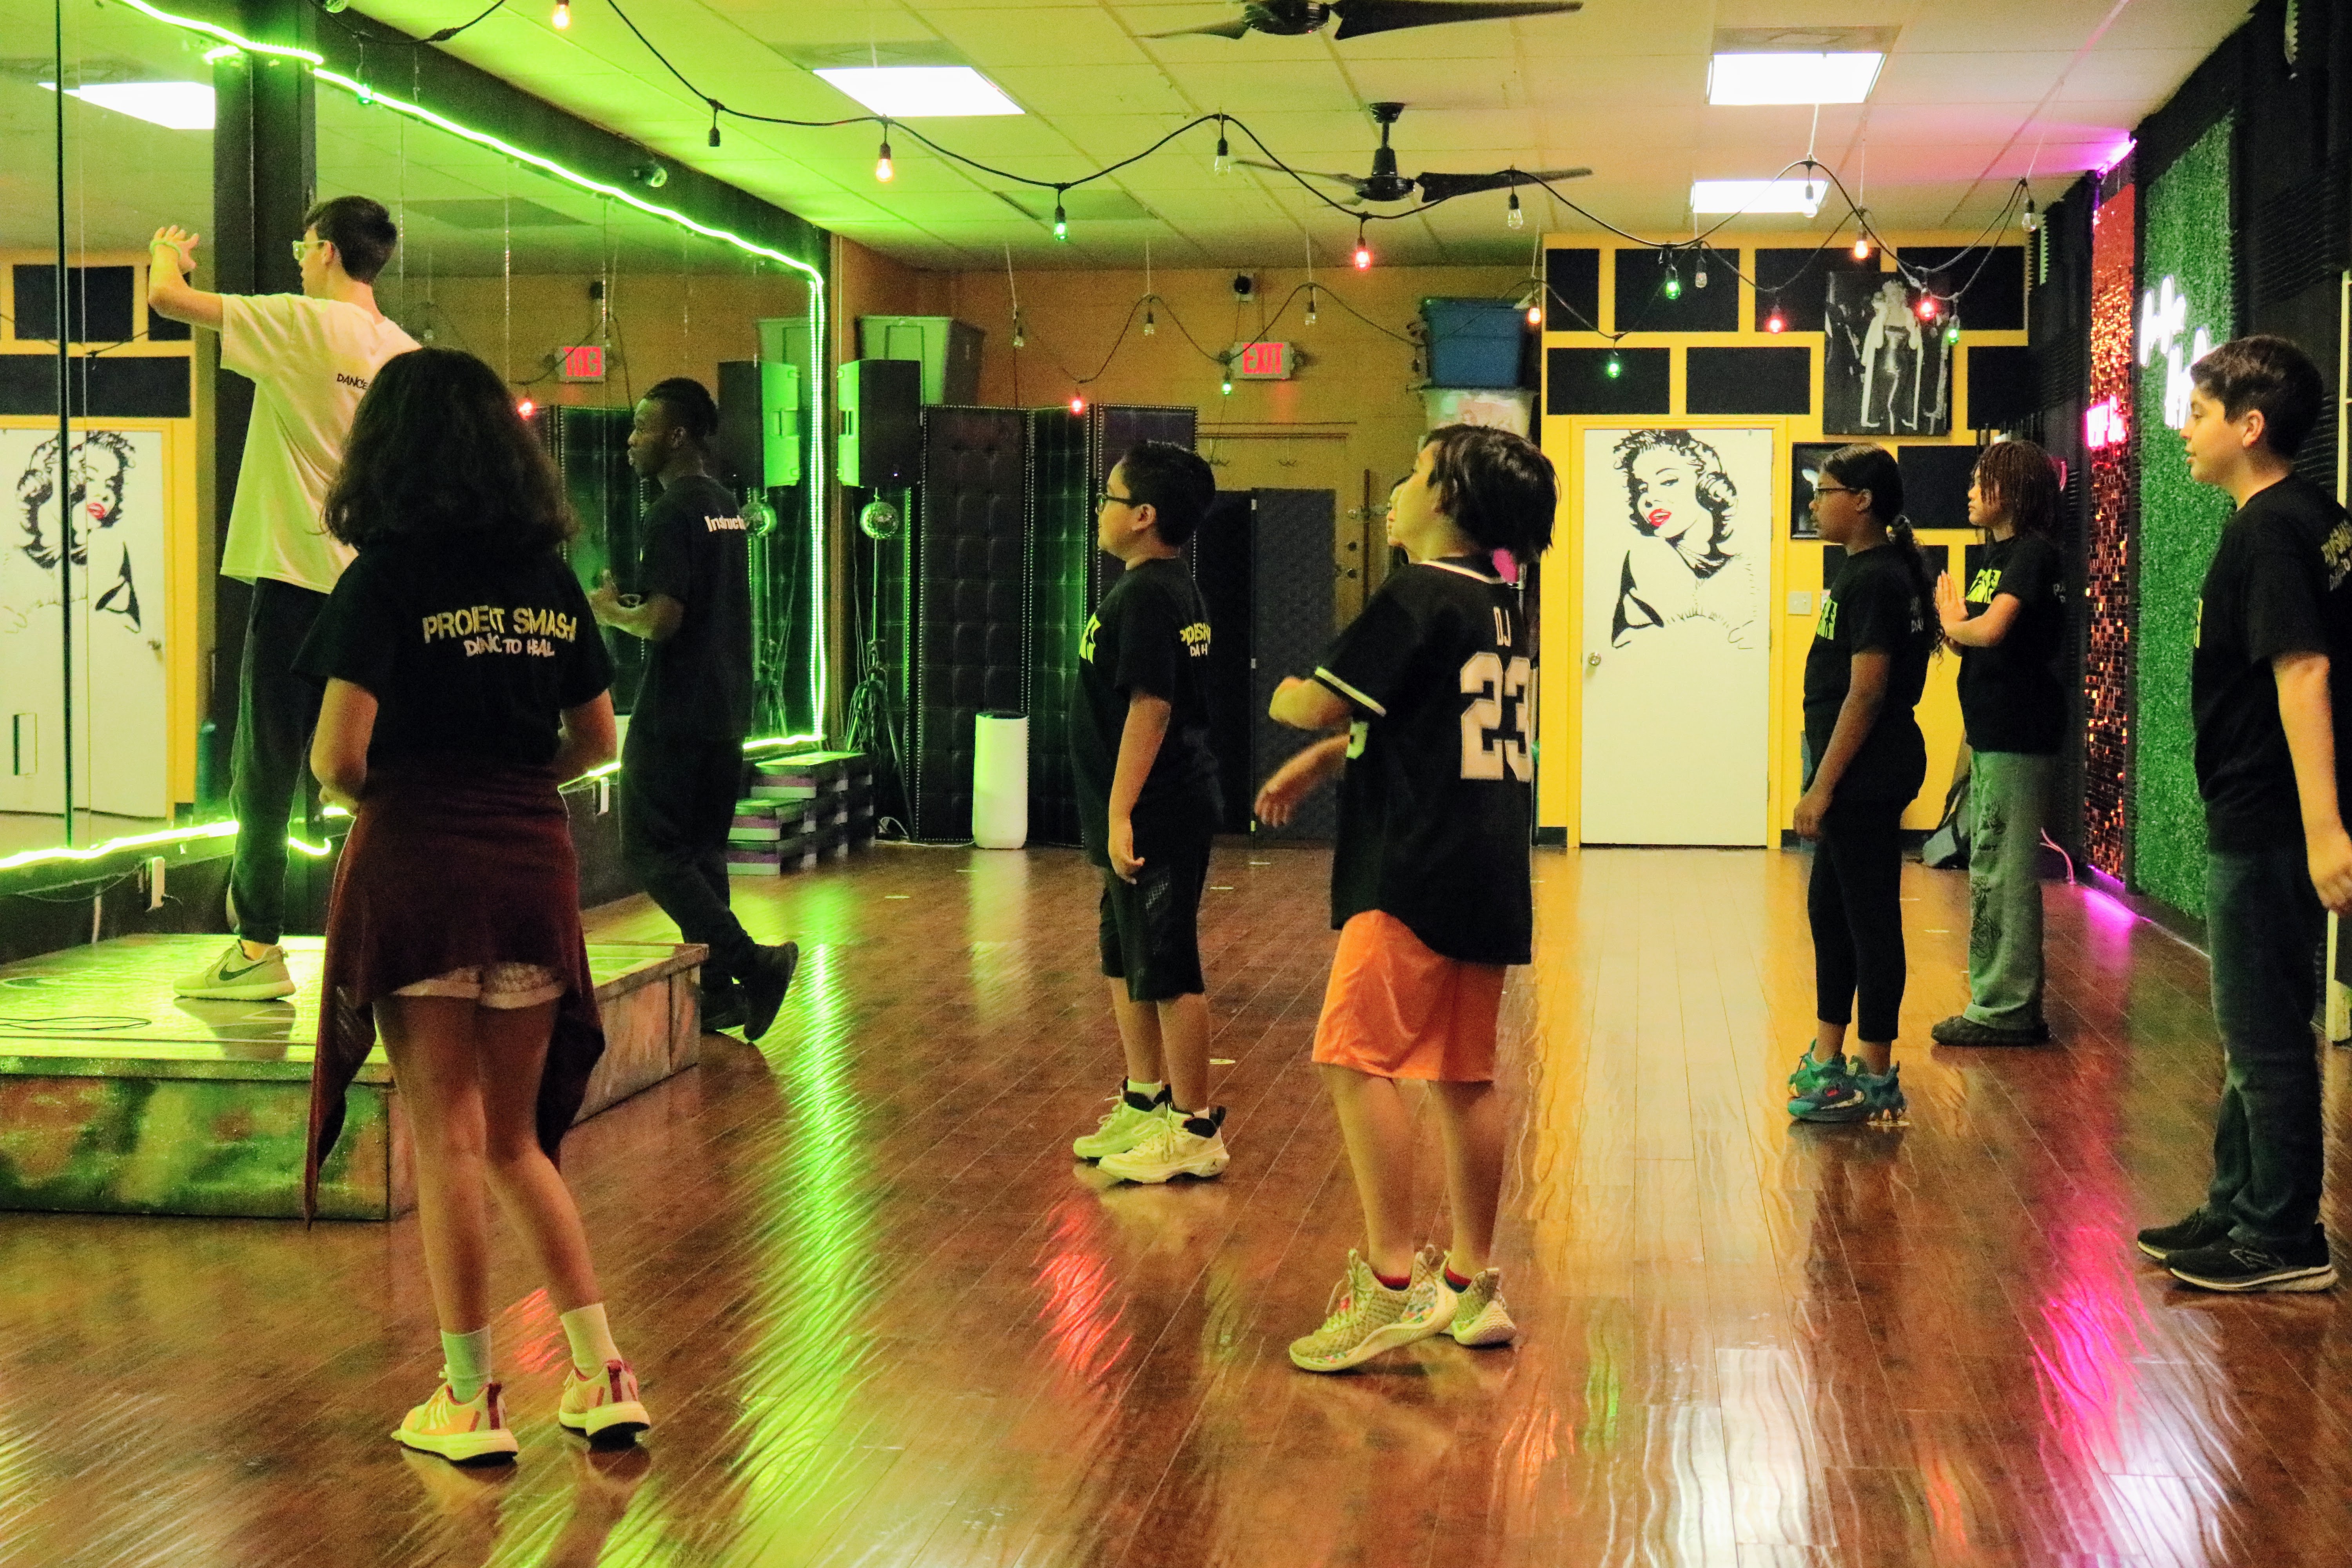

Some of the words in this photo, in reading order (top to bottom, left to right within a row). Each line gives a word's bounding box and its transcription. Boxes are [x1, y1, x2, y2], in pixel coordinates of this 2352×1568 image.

[1243, 343, 1284, 374] EXIT
[502, 638, 522, 654] TO
[526, 638, 555, 657] HEAL
[1460, 650, 1534, 783] 23
